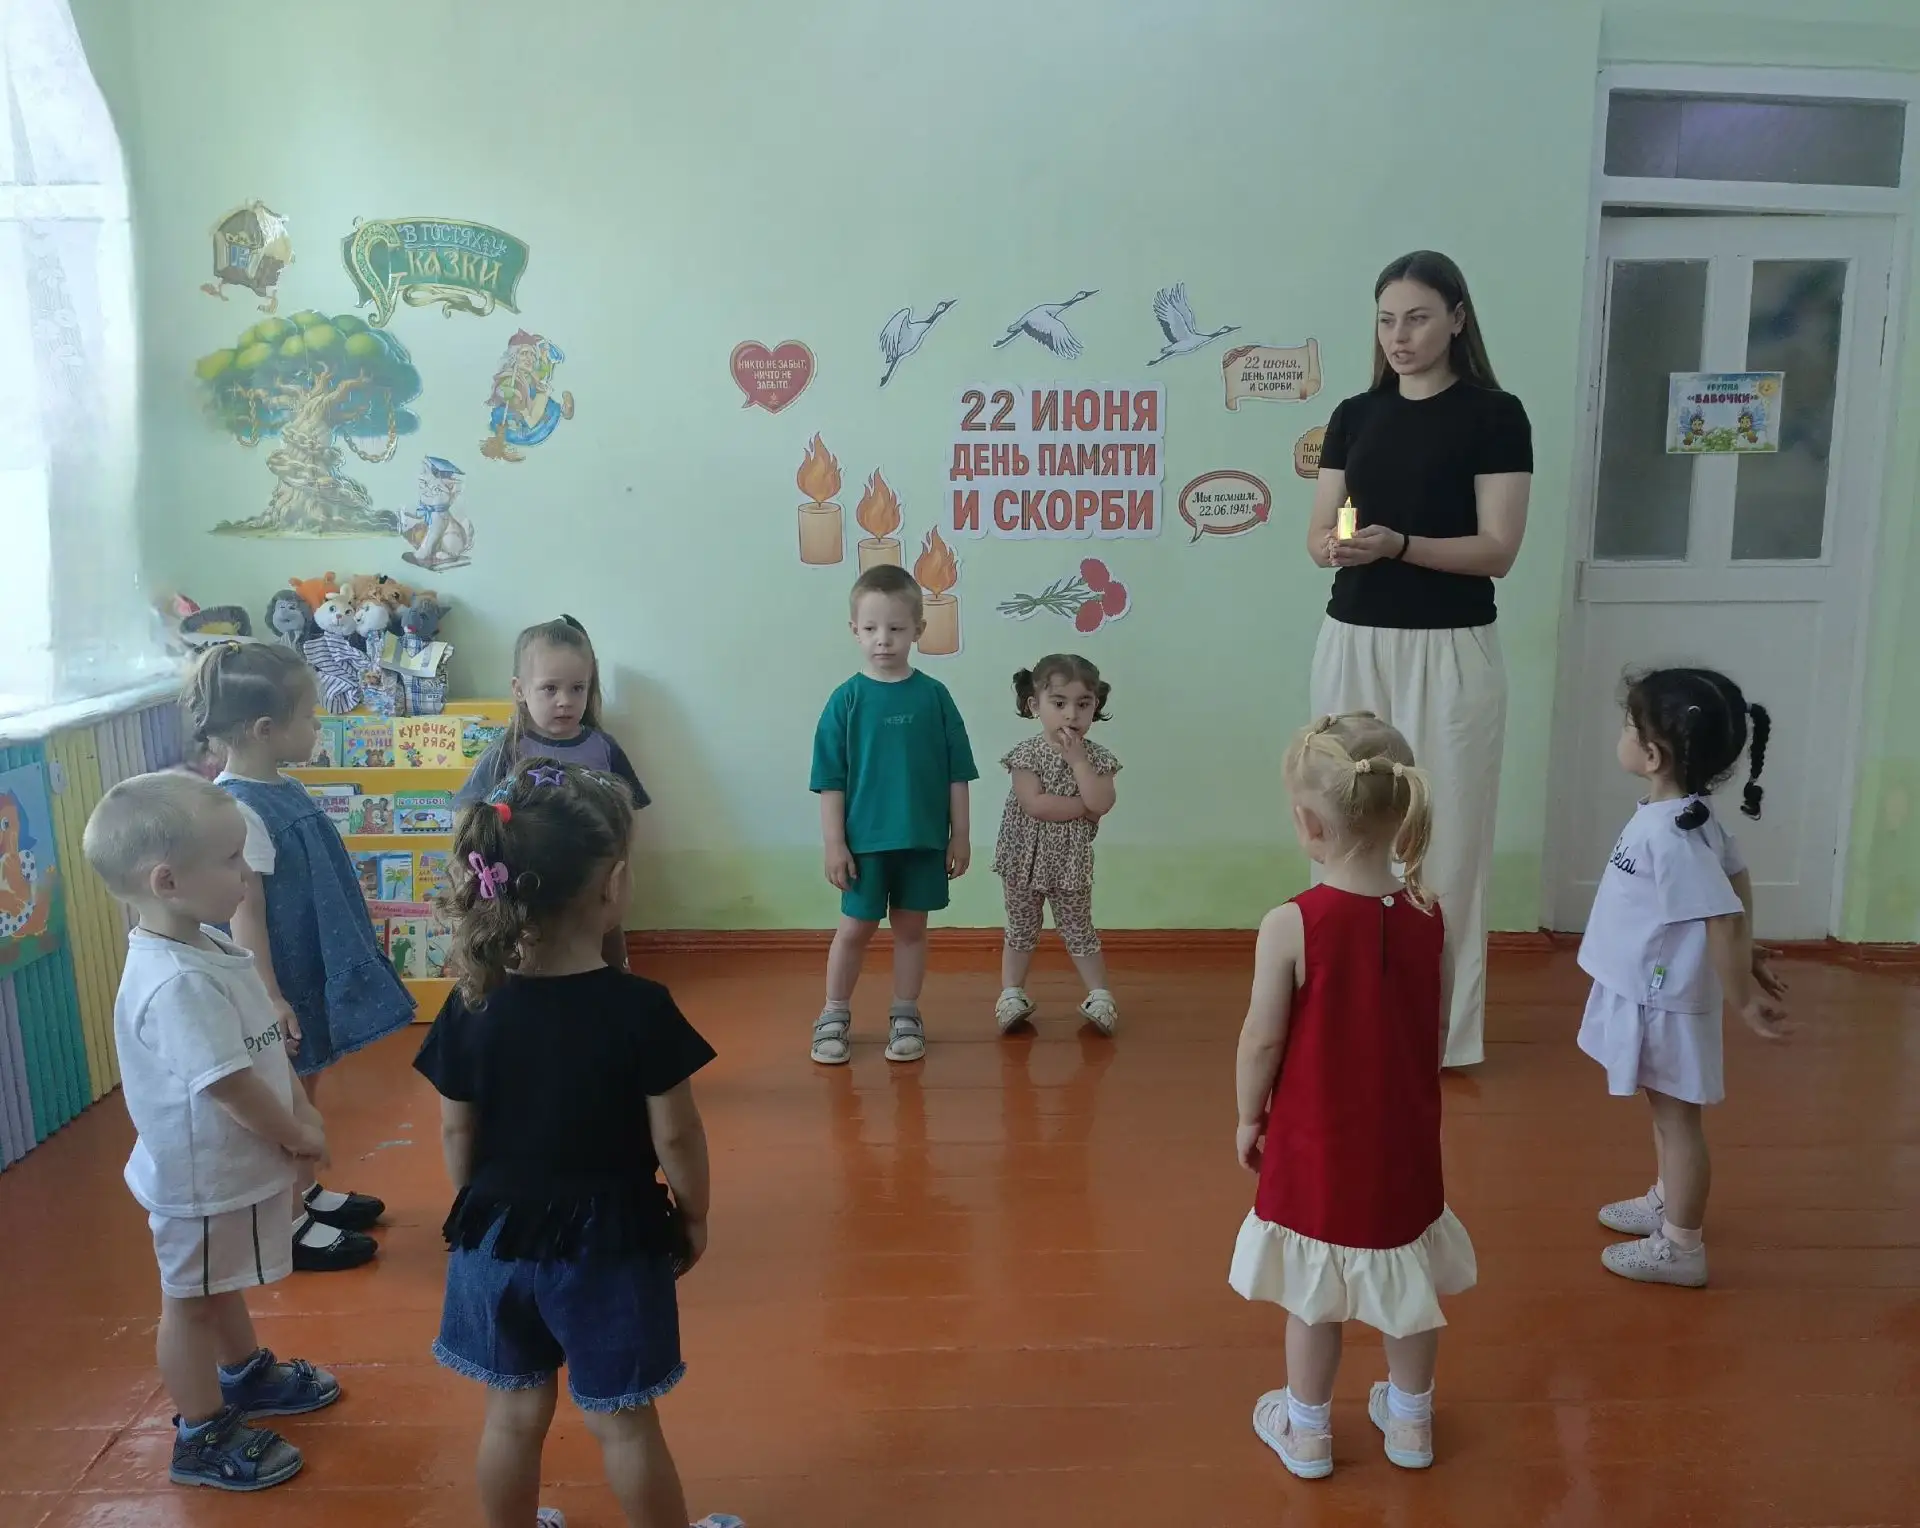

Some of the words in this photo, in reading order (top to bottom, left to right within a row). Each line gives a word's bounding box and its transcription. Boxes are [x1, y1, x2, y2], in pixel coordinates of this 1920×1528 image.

[420, 223, 485, 250] ГОСТЯХ
[739, 359, 765, 369] НИКТО
[766, 359, 777, 369] НЕ
[1243, 355, 1260, 369] 22
[754, 370, 780, 380] НИЧТО
[781, 370, 792, 379] НЕ
[1241, 371, 1265, 382] ДЕНЬ
[1266, 370, 1304, 381] ПАМЯТИ
[1249, 383, 1256, 392] И
[1257, 382, 1295, 392] СКОРБИ.
[960, 389, 1016, 432] 22
[1031, 388, 1158, 432] ИЮНЯ
[1303, 443, 1322, 453] ПАМ
[950, 443, 1030, 482] ДЕНЬ
[1037, 443, 1156, 477] ПАМЯТИ
[1302, 455, 1320, 464] ПОД
[1192, 492, 1212, 503] Мы
[1214, 491, 1258, 502] помним.
[953, 489, 980, 531] И
[993, 489, 1154, 531] СКОРБИ
[399, 722, 456, 738] КУРОЧКА
[423, 736, 457, 751] РЯБА
